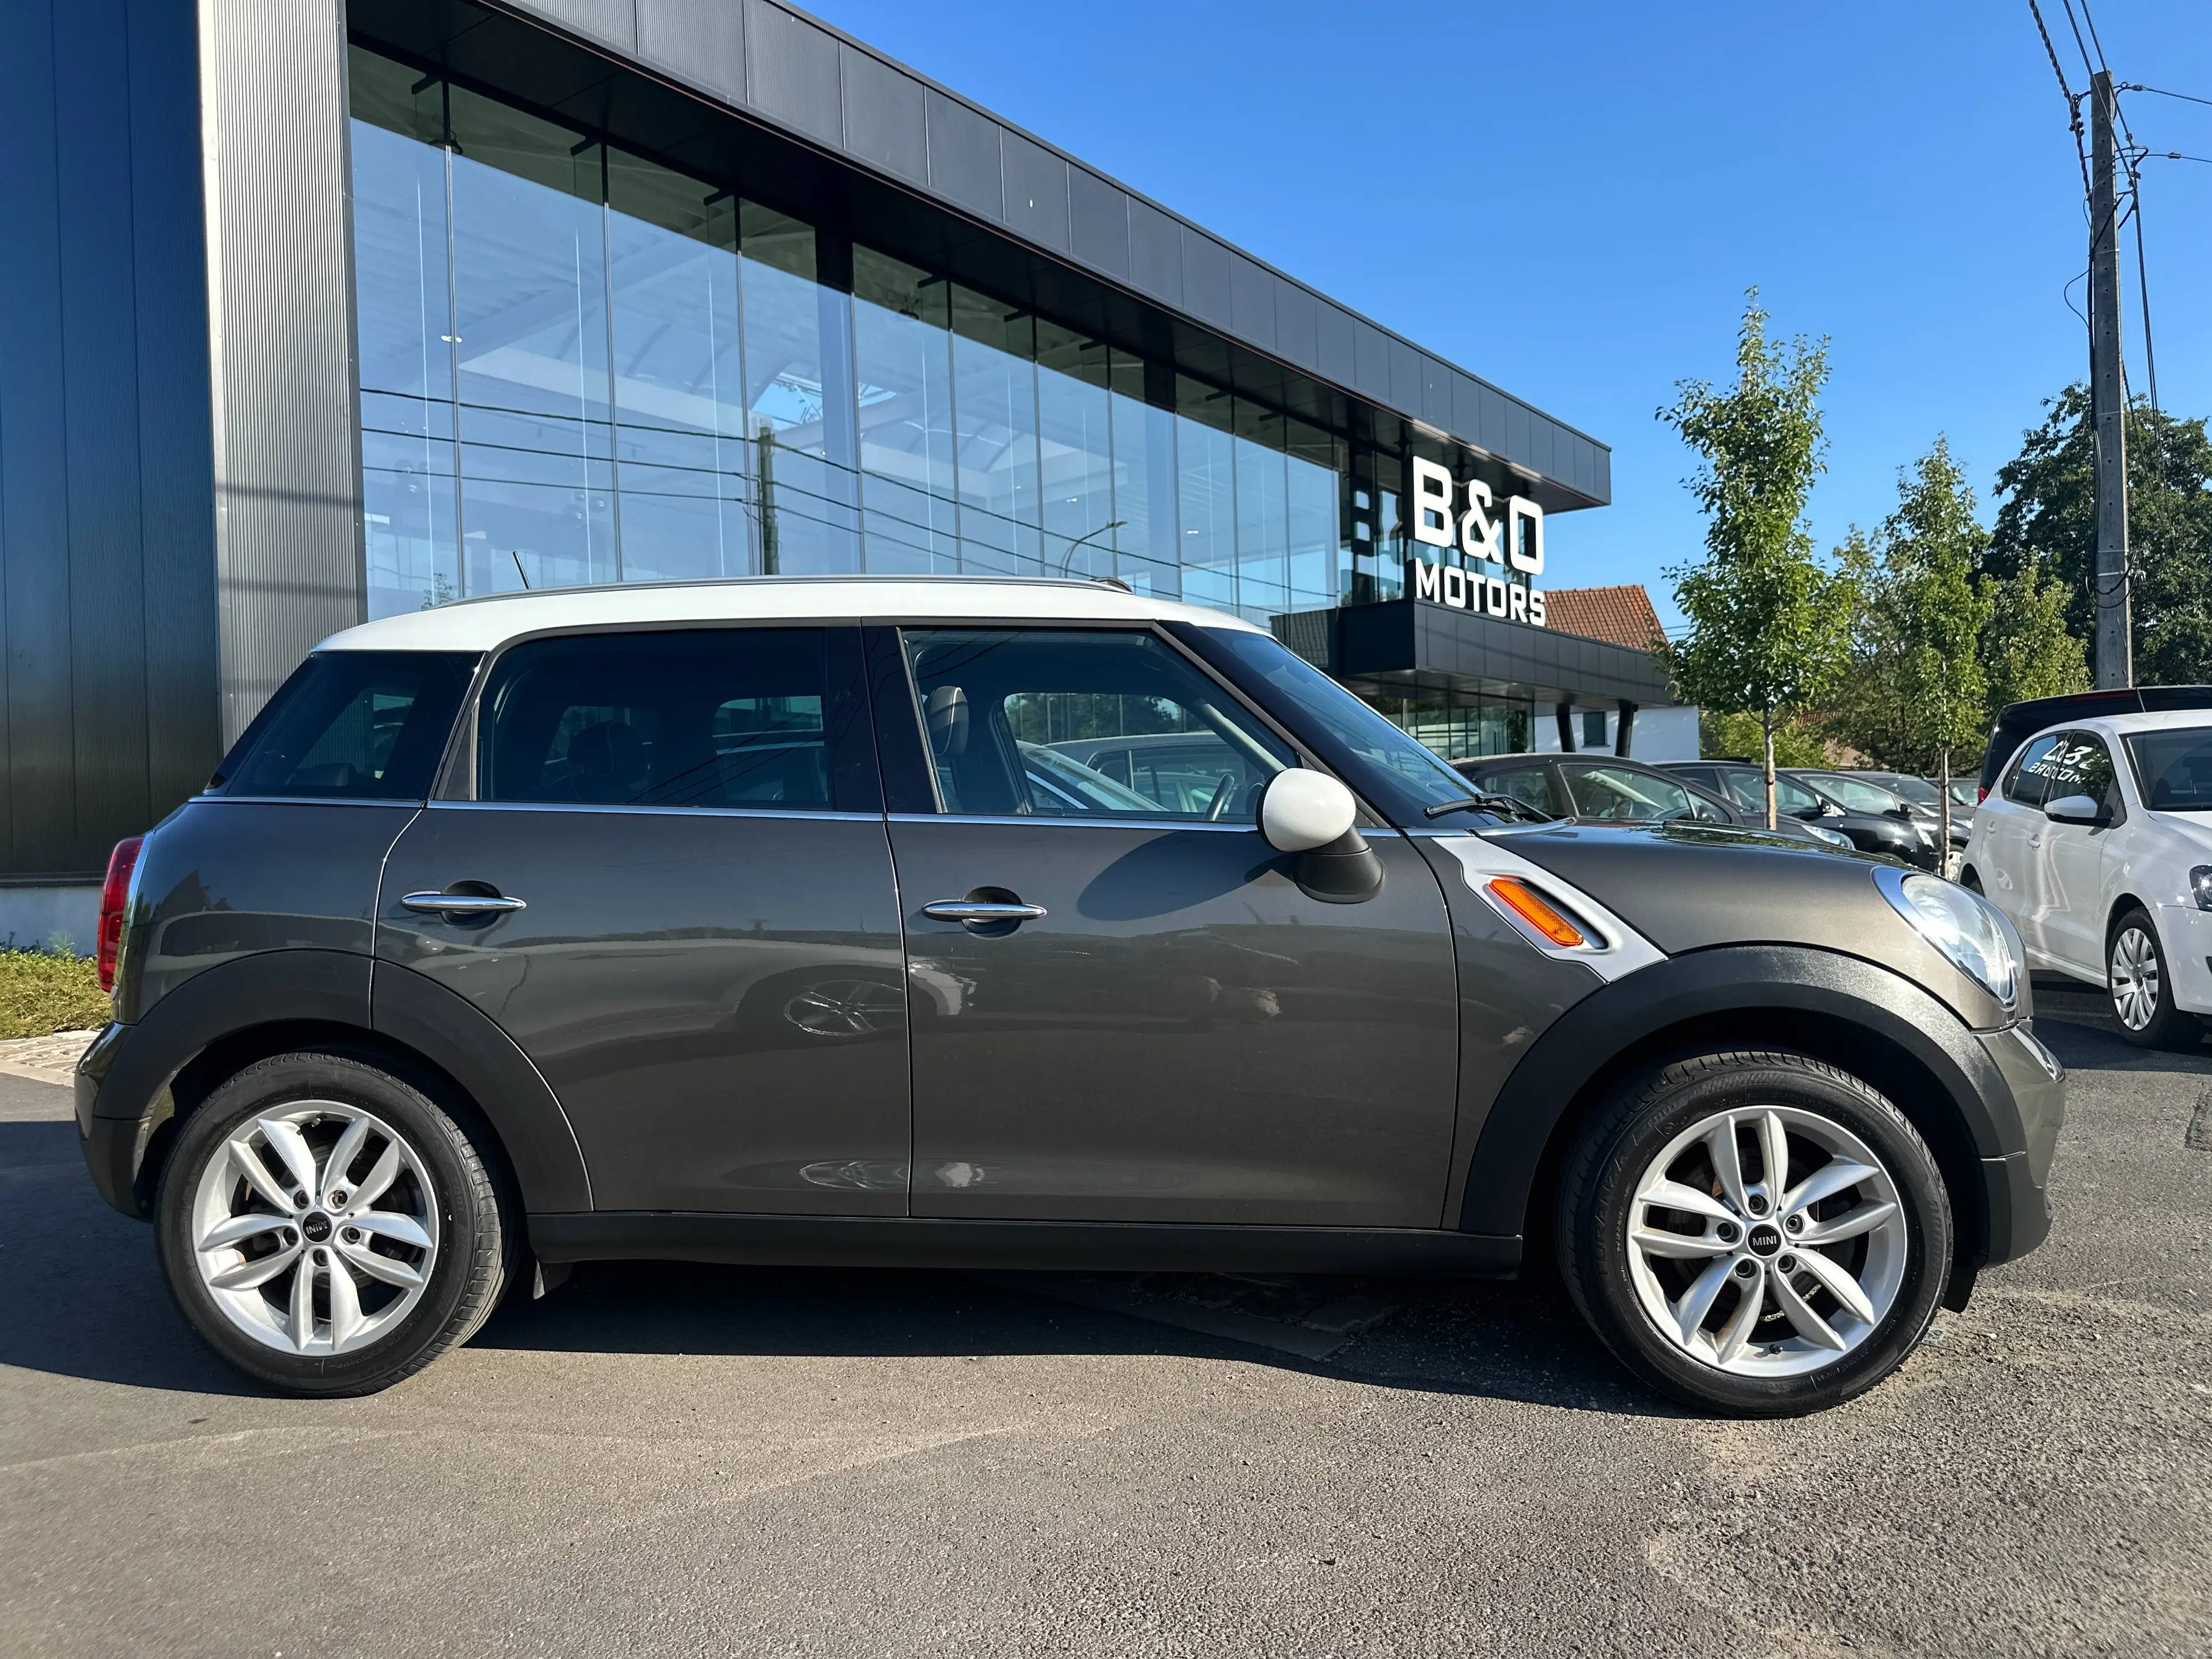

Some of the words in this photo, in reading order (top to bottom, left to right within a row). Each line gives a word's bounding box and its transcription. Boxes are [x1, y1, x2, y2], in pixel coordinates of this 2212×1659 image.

[1413, 456, 1544, 575] B&O
[1415, 558, 1546, 627] MOTORS
[306, 1221, 328, 1234] MINI
[1752, 1235, 1777, 1246] MINI
